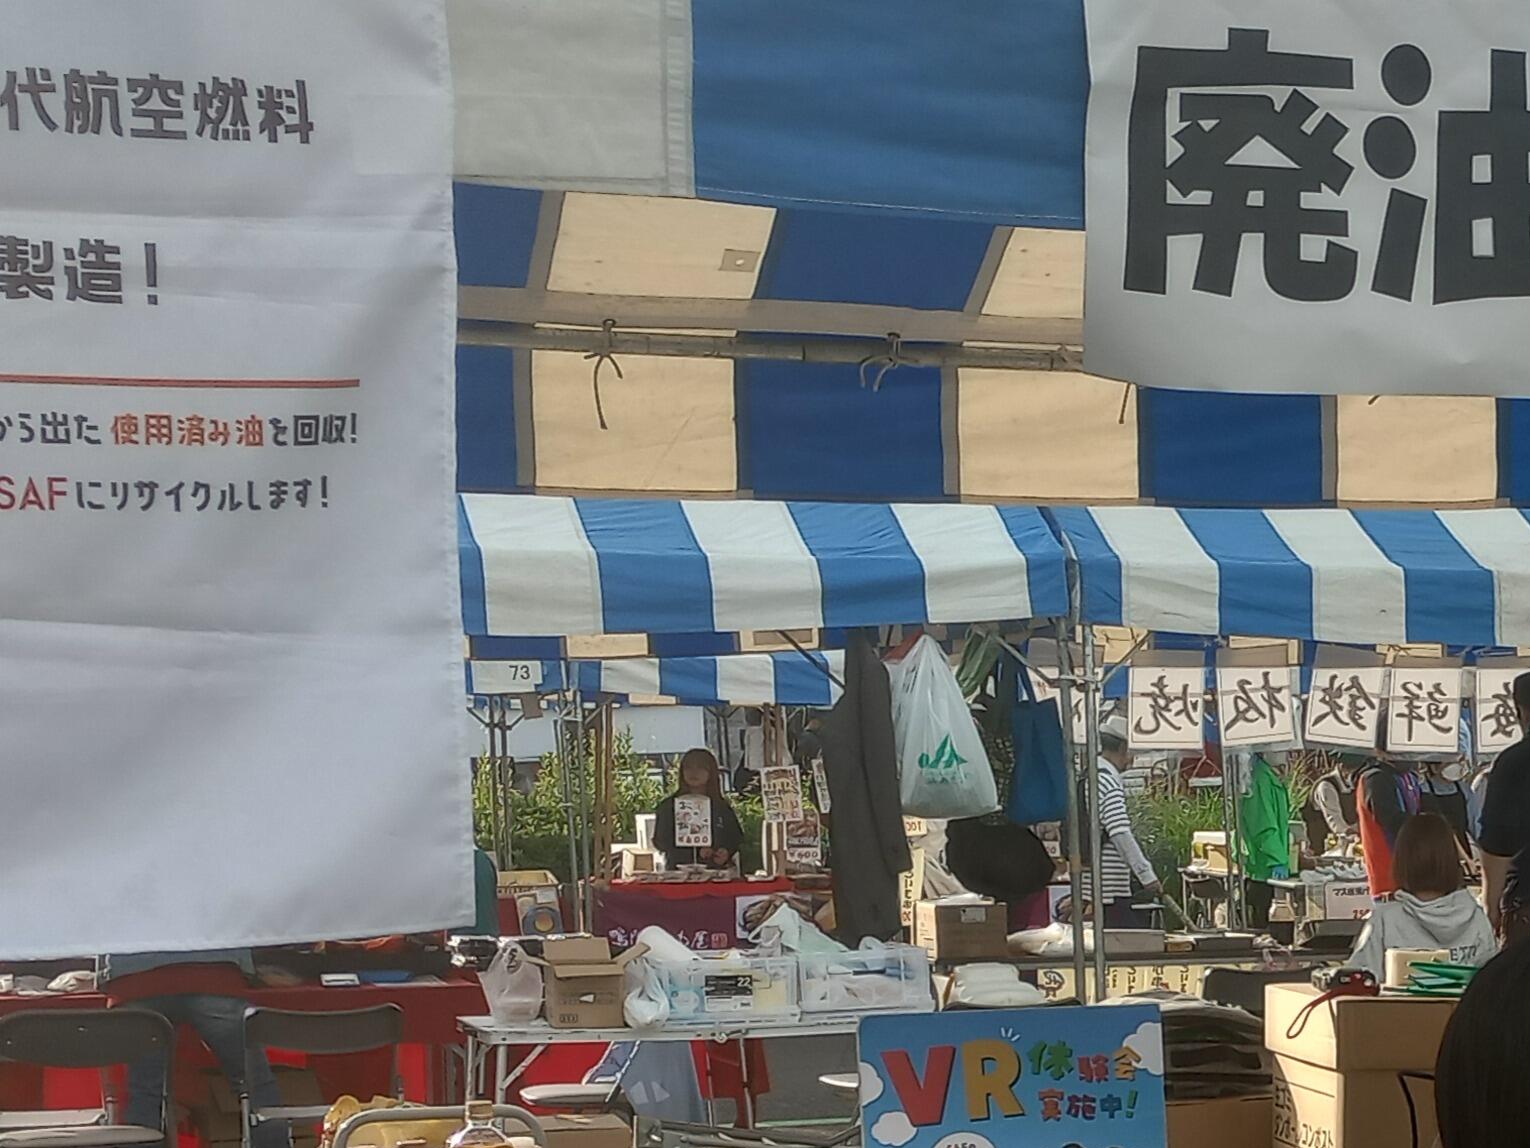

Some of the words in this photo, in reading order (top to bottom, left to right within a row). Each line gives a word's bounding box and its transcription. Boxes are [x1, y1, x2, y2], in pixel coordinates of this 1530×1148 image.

[0, 67, 314, 144] 代航空燃料
[508, 664, 531, 681] 73
[882, 1040, 1025, 1126] VR
[1027, 1040, 1142, 1083] 体験会
